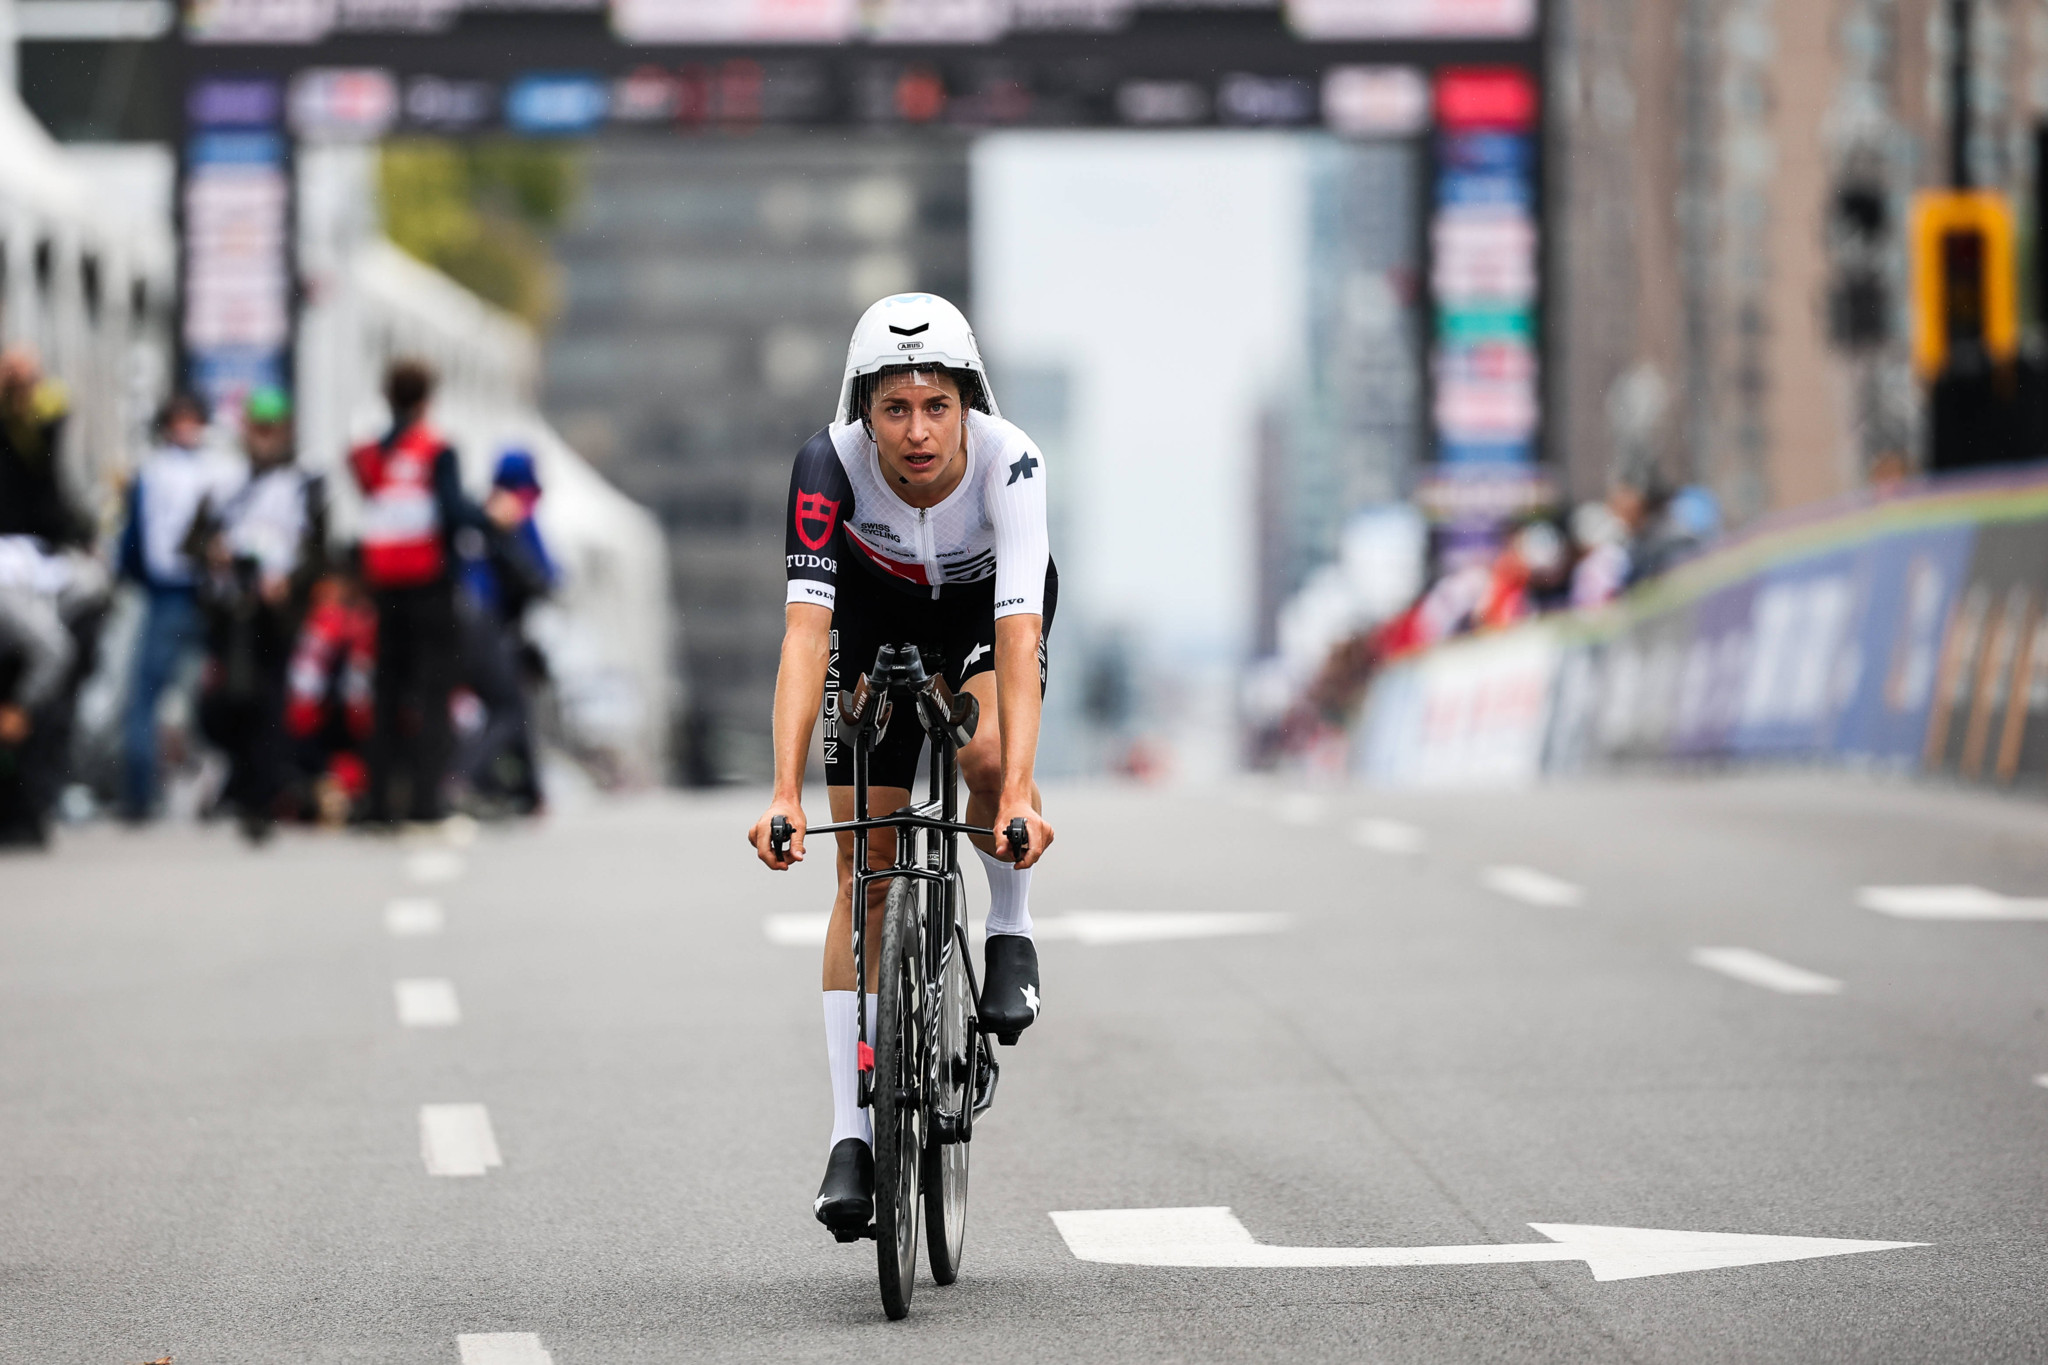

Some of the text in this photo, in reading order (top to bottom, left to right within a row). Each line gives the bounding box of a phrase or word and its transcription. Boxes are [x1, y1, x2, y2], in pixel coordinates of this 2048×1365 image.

[861, 522, 890, 532] SWISS
[861, 528, 901, 543] CYCLING
[786, 554, 838, 575] TUDOR
[805, 588, 835, 601] VOLV
[994, 597, 1025, 609] OLVO
